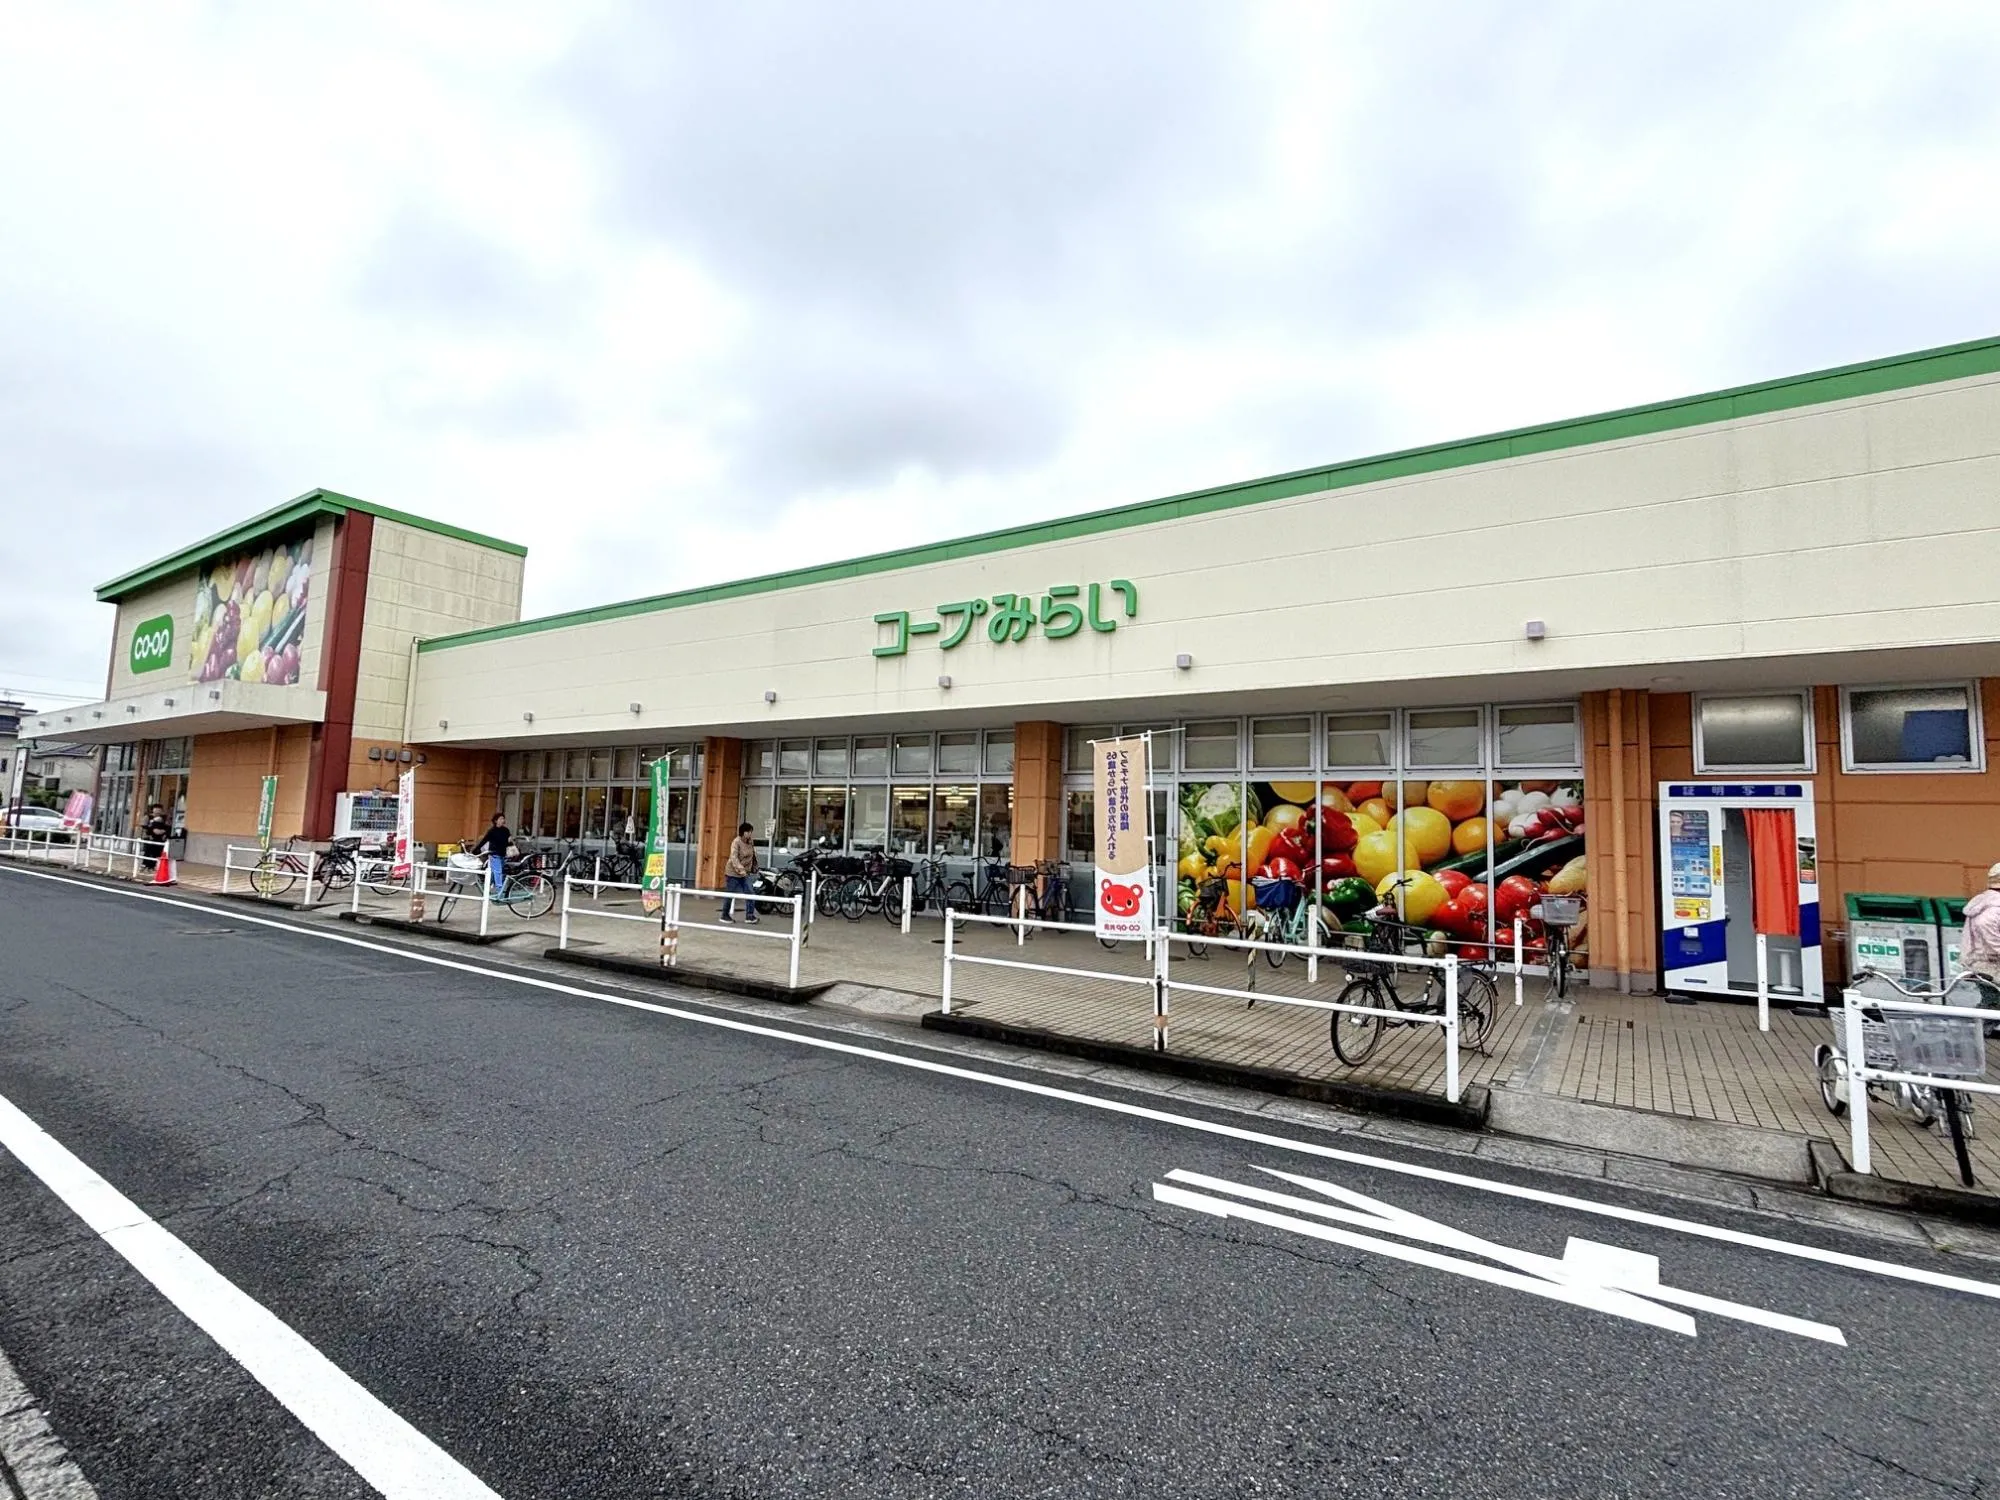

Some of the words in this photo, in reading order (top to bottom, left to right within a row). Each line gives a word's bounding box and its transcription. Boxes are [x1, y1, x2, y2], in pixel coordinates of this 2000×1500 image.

[872, 580, 1137, 656] コープみらい
